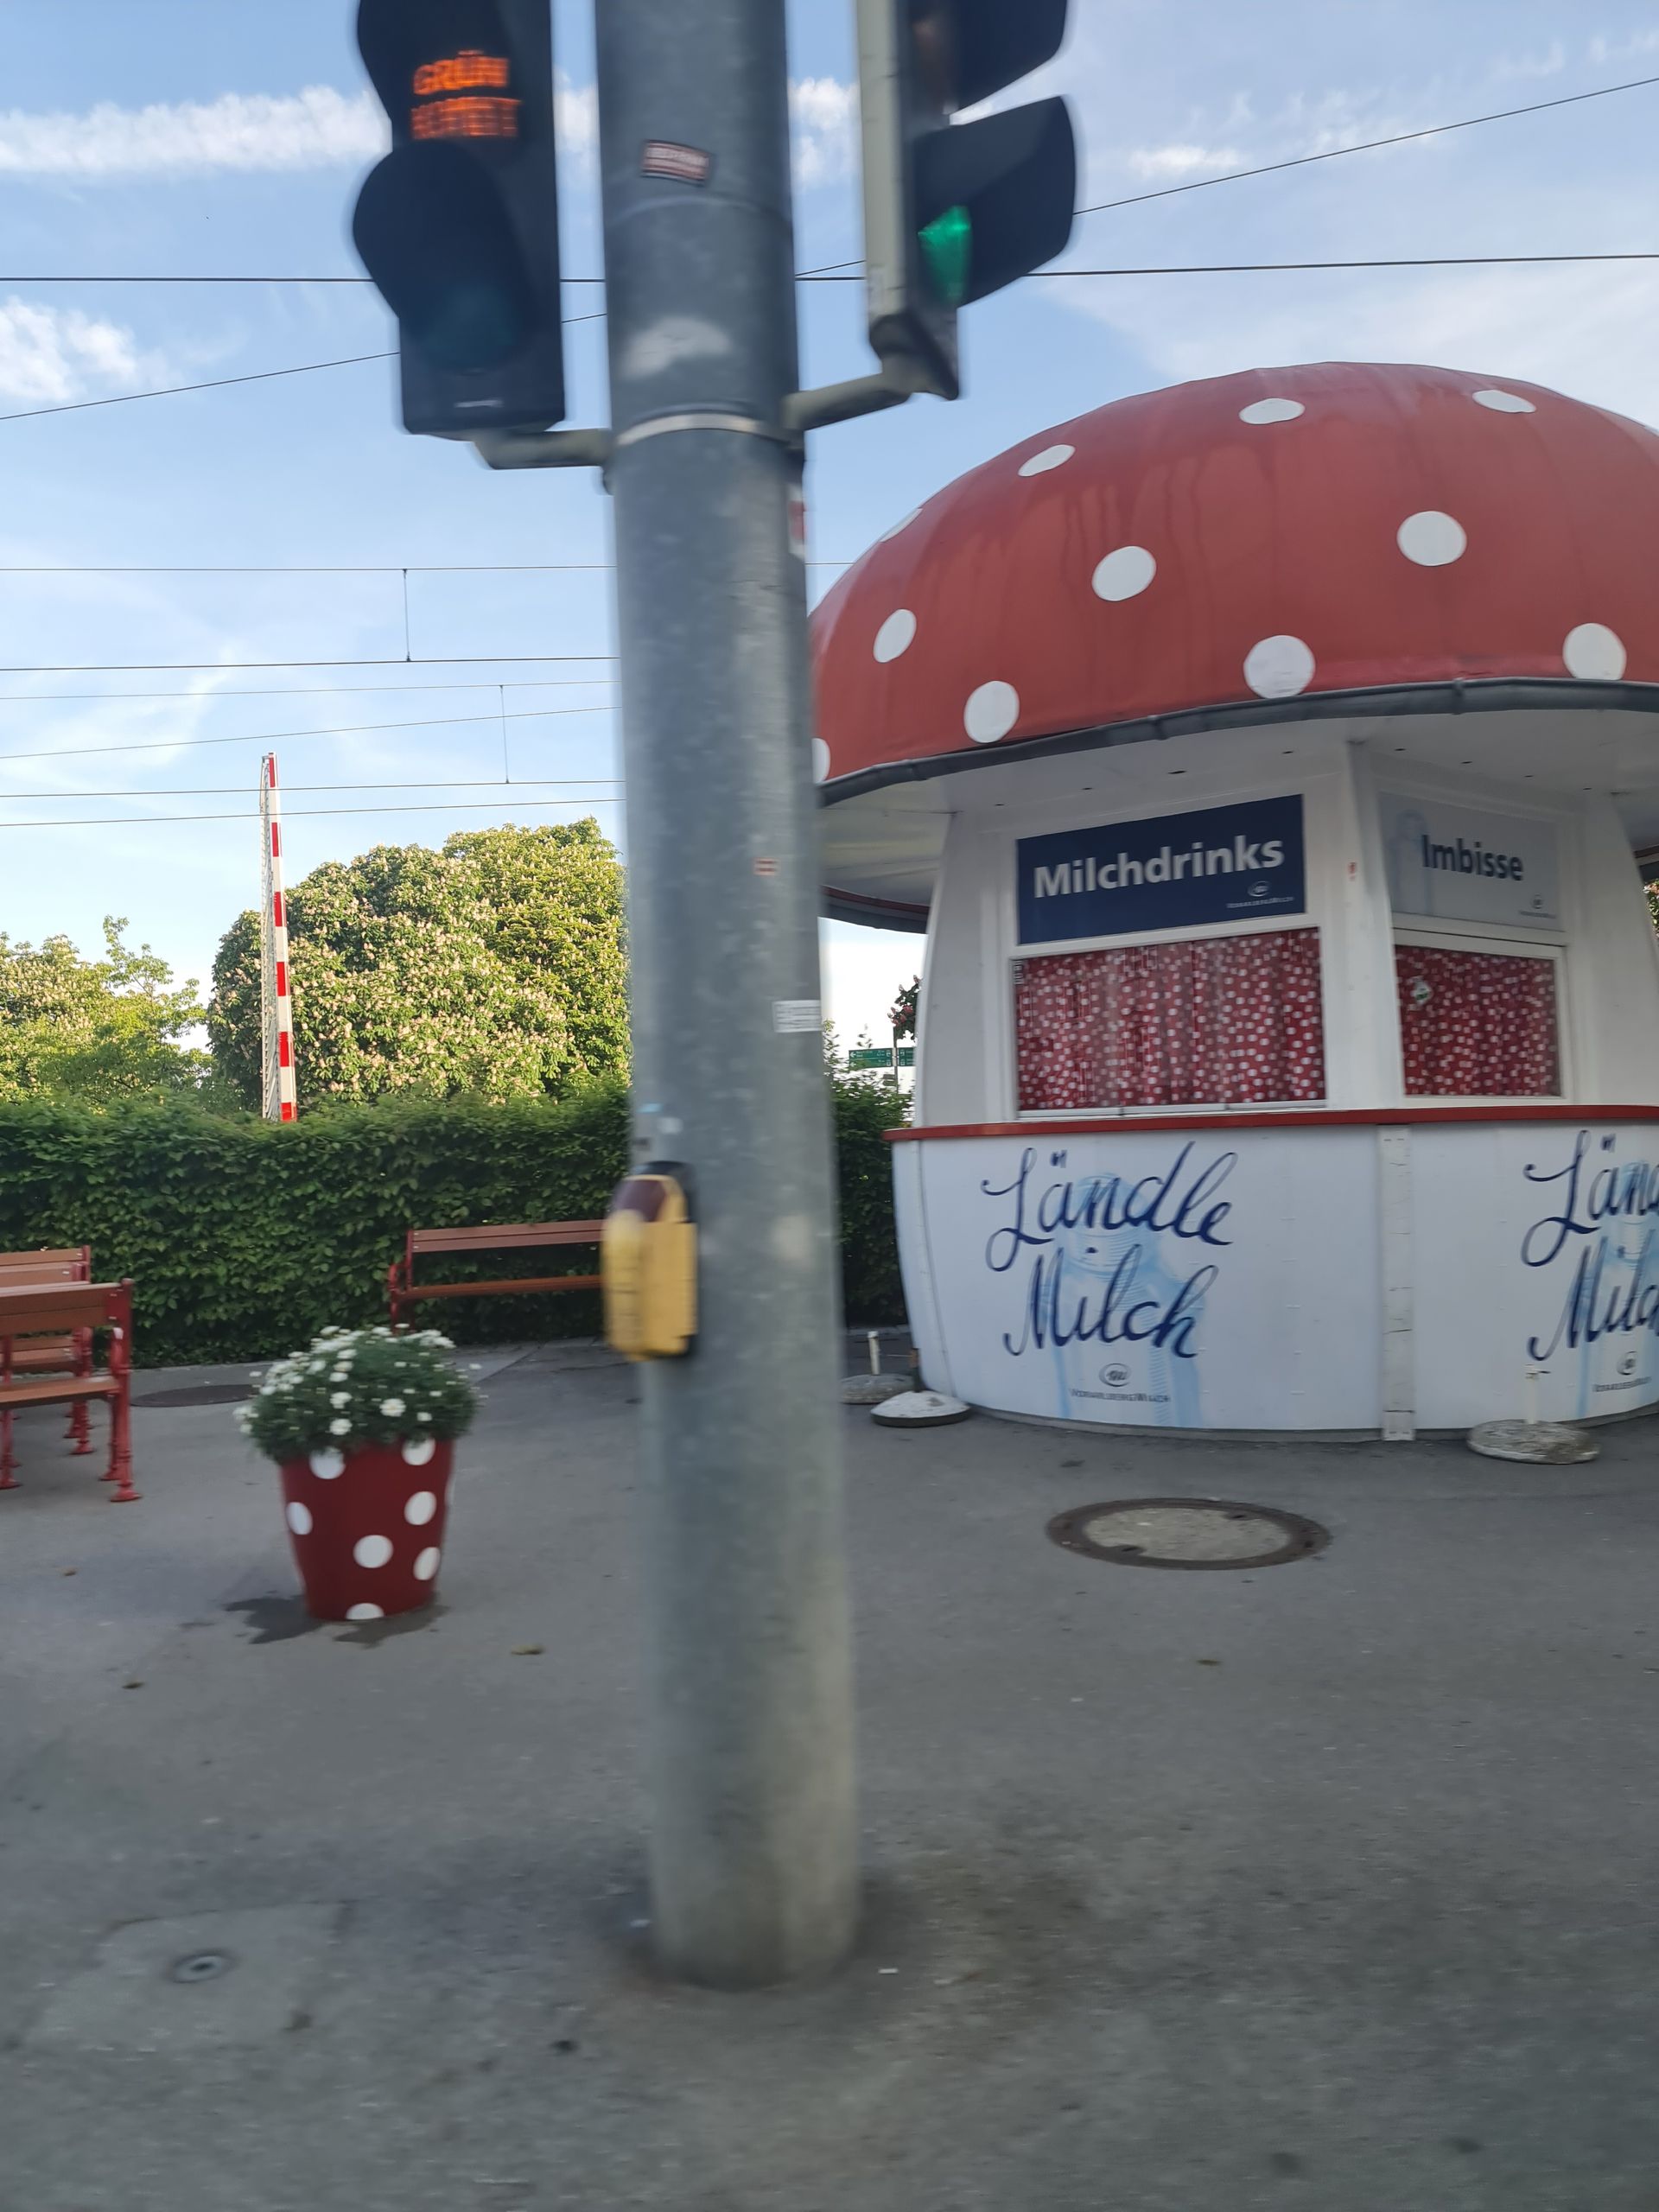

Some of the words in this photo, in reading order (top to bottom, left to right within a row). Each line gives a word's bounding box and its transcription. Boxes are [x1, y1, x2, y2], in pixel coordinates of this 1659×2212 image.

[1033, 835, 1285, 898] Milchdrinks
[1421, 834, 1523, 881] Imbisse
[982, 1141, 1238, 1272] Ländle
[1003, 1243, 1219, 1358] Milch
